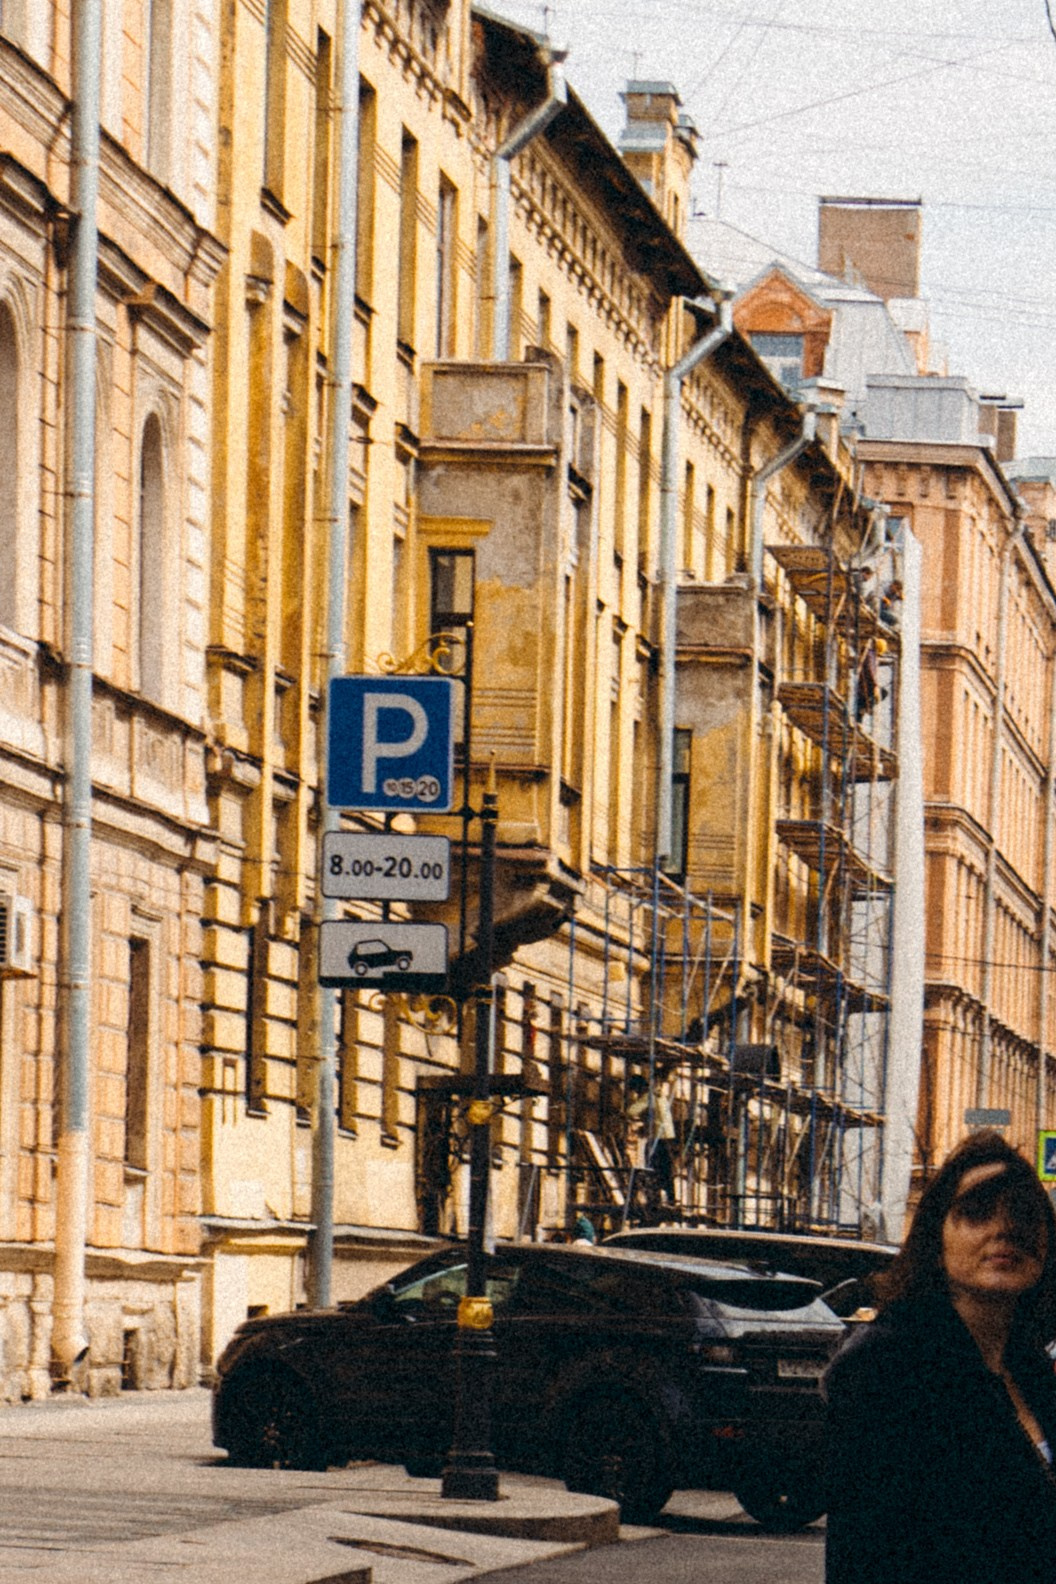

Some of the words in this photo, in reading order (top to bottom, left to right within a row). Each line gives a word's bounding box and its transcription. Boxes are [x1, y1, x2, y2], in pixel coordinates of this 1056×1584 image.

[361, 692, 429, 794] P
[401, 781, 414, 795] 15
[419, 780, 439, 796] 20
[329, 854, 443, 880] 8.00-20.00
